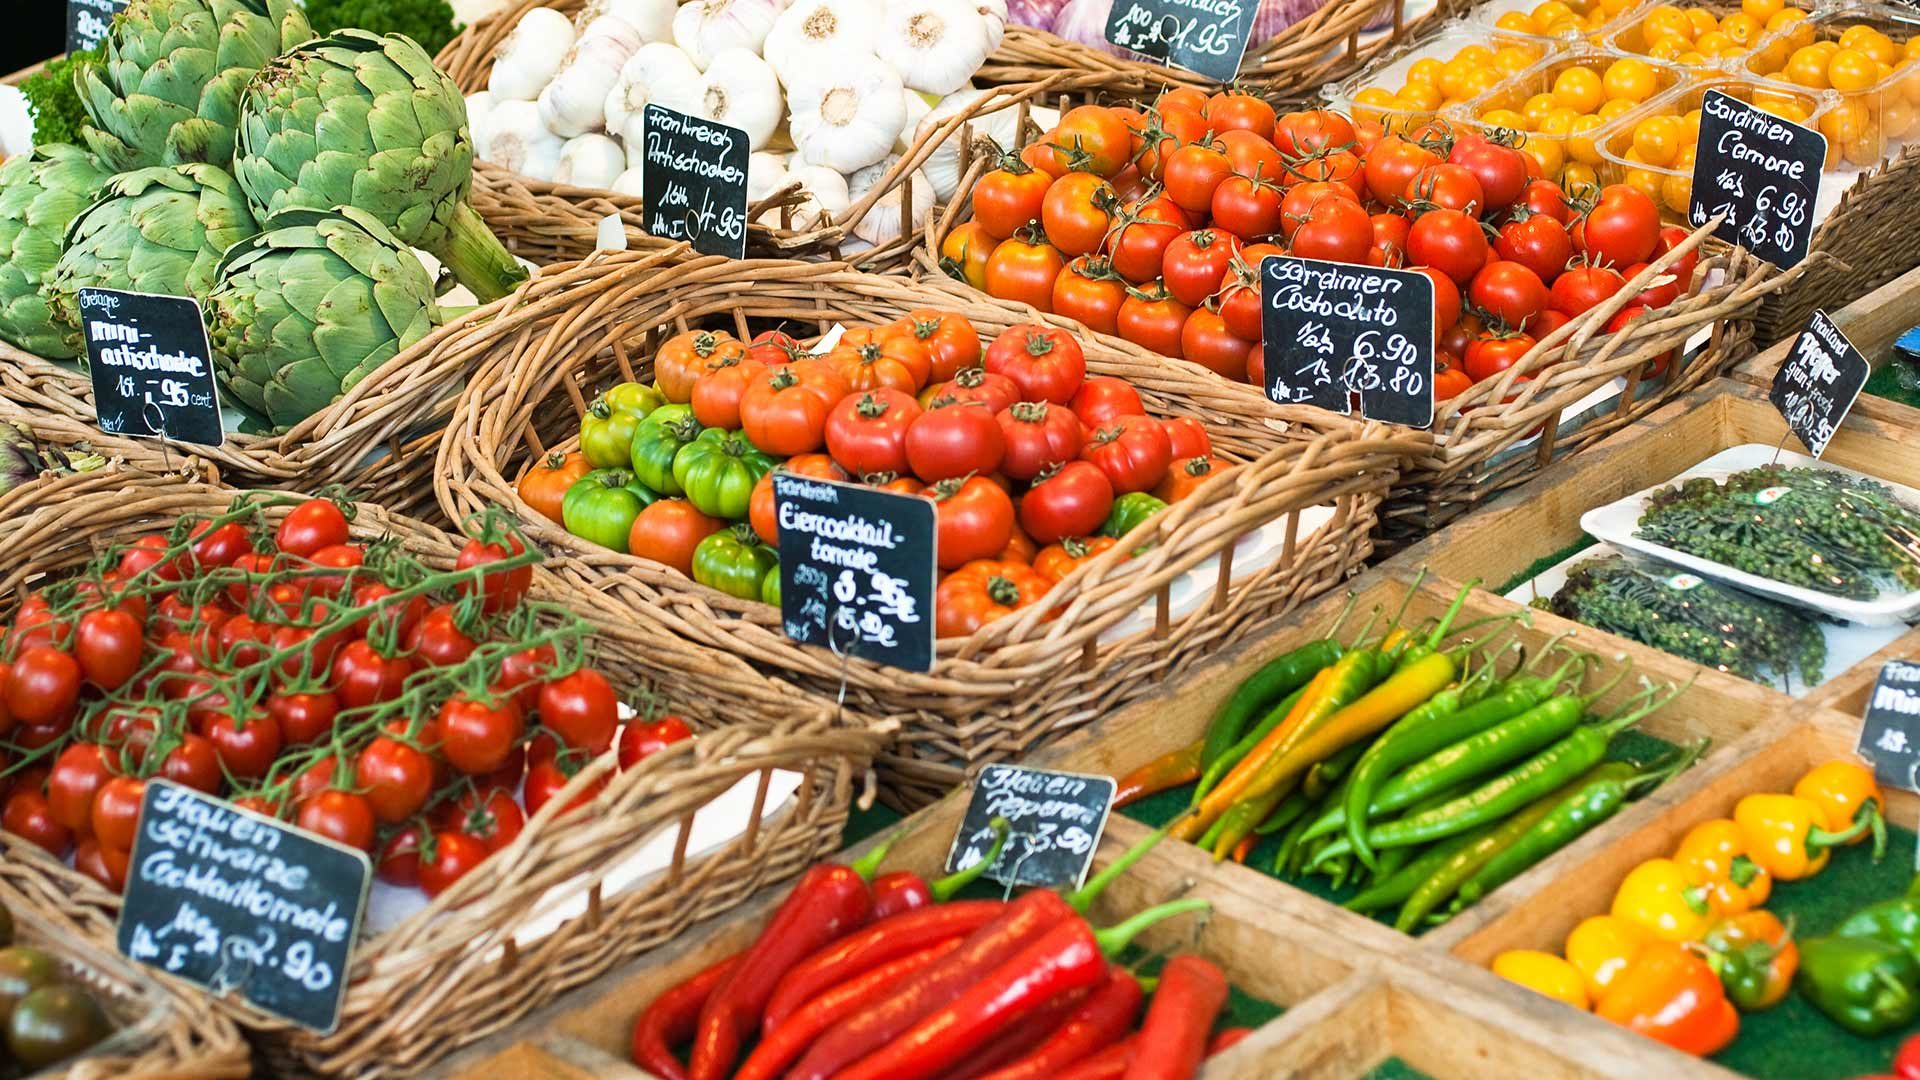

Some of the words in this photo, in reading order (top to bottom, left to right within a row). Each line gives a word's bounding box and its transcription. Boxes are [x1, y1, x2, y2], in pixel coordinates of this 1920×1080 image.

[1168, 18, 1236, 55] 1.95
[648, 105, 733, 149] Frankreich
[1704, 96, 1794, 145] Sardinien
[1717, 130, 1805, 180] Camone
[700, 186, 746, 240] 4.95
[1756, 185, 1807, 227] 6.90
[1269, 260, 1403, 295] Sardinien
[1353, 330, 1418, 366] 6.90
[1809, 311, 1850, 358] Thailand
[1339, 357, 1423, 396] 13.80
[191, 390, 214, 409] cent
[810, 536, 880, 575] tomate
[981, 768, 1086, 797] Italien
[153, 786, 282, 852] Italien
[231, 925, 334, 991] 2.90
